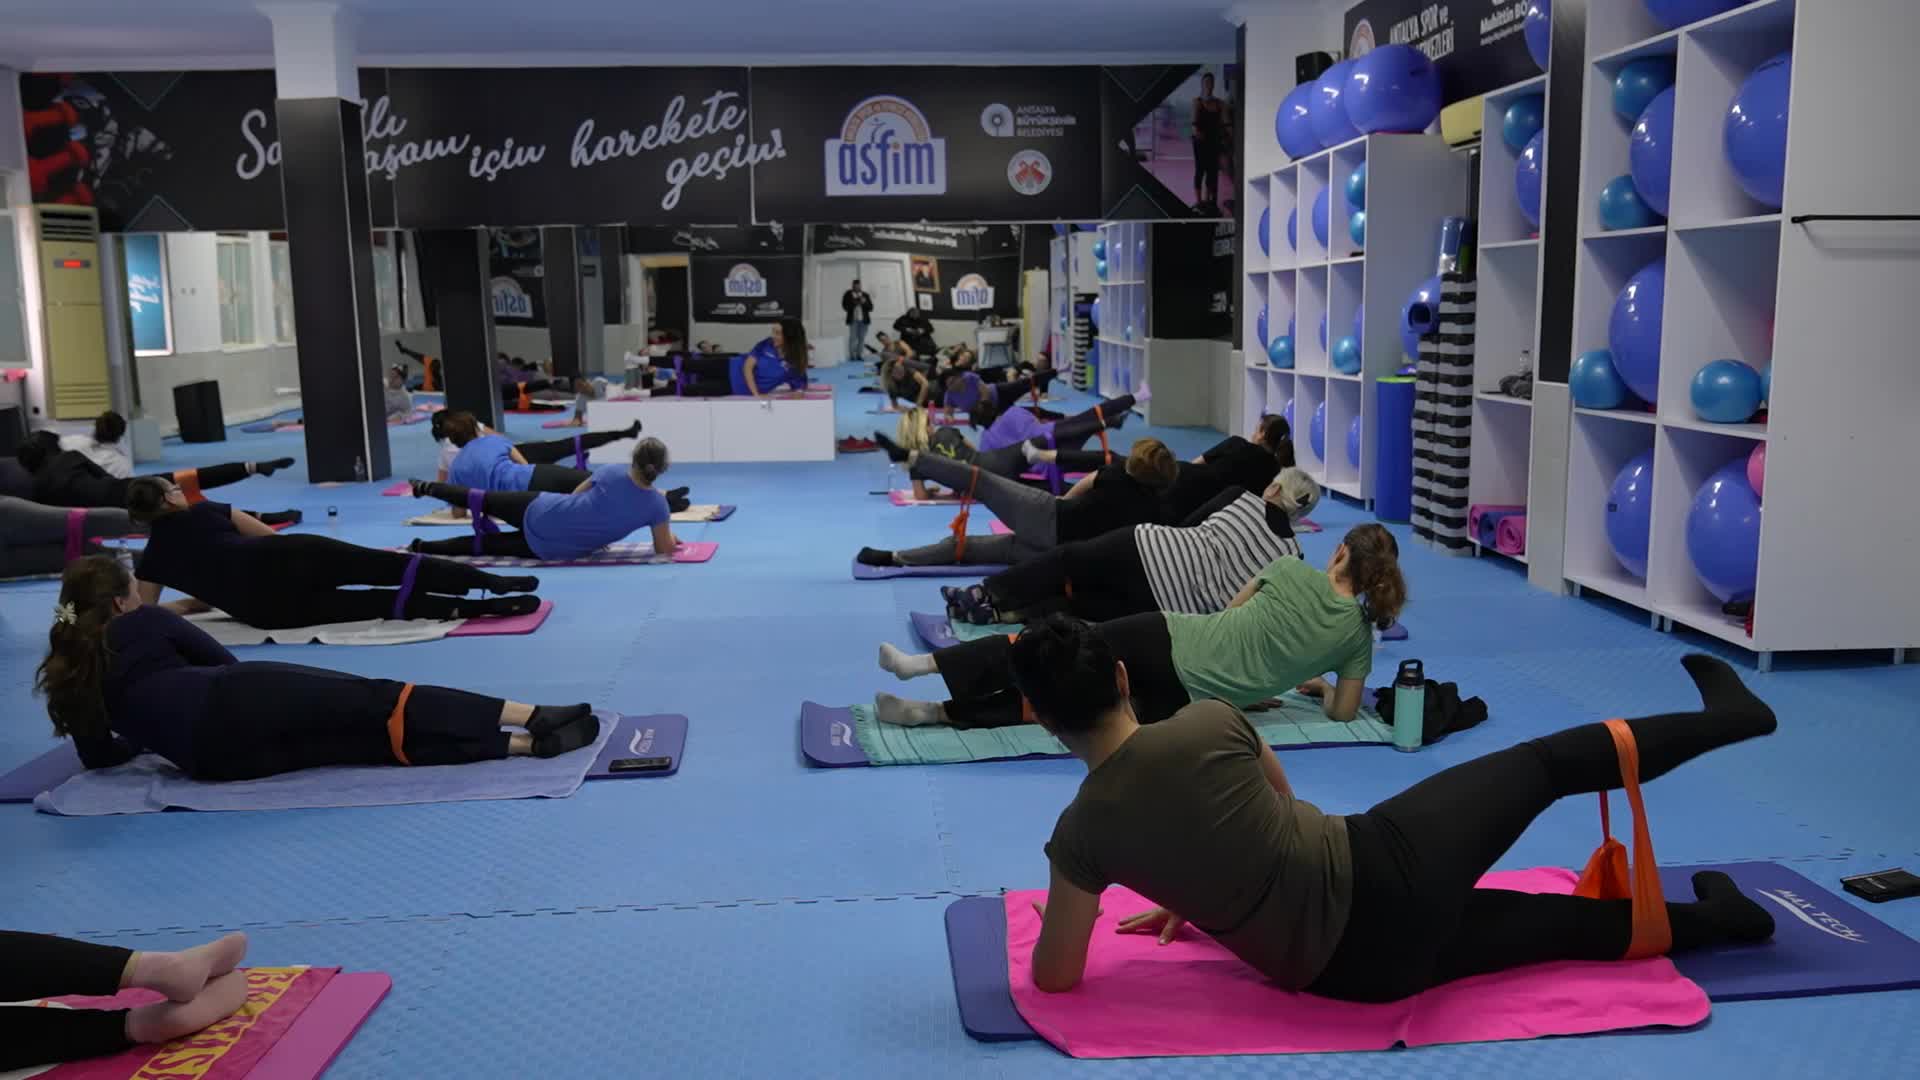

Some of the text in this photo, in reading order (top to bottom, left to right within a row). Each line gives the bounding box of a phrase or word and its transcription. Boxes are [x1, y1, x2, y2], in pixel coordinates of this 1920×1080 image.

[364, 90, 748, 181] aşam için harekete
[1016, 105, 1056, 113] ANTALYA
[660, 128, 786, 211] geçin!
[838, 128, 935, 192] asfim
[1774, 888, 1864, 938] MAX TECH
